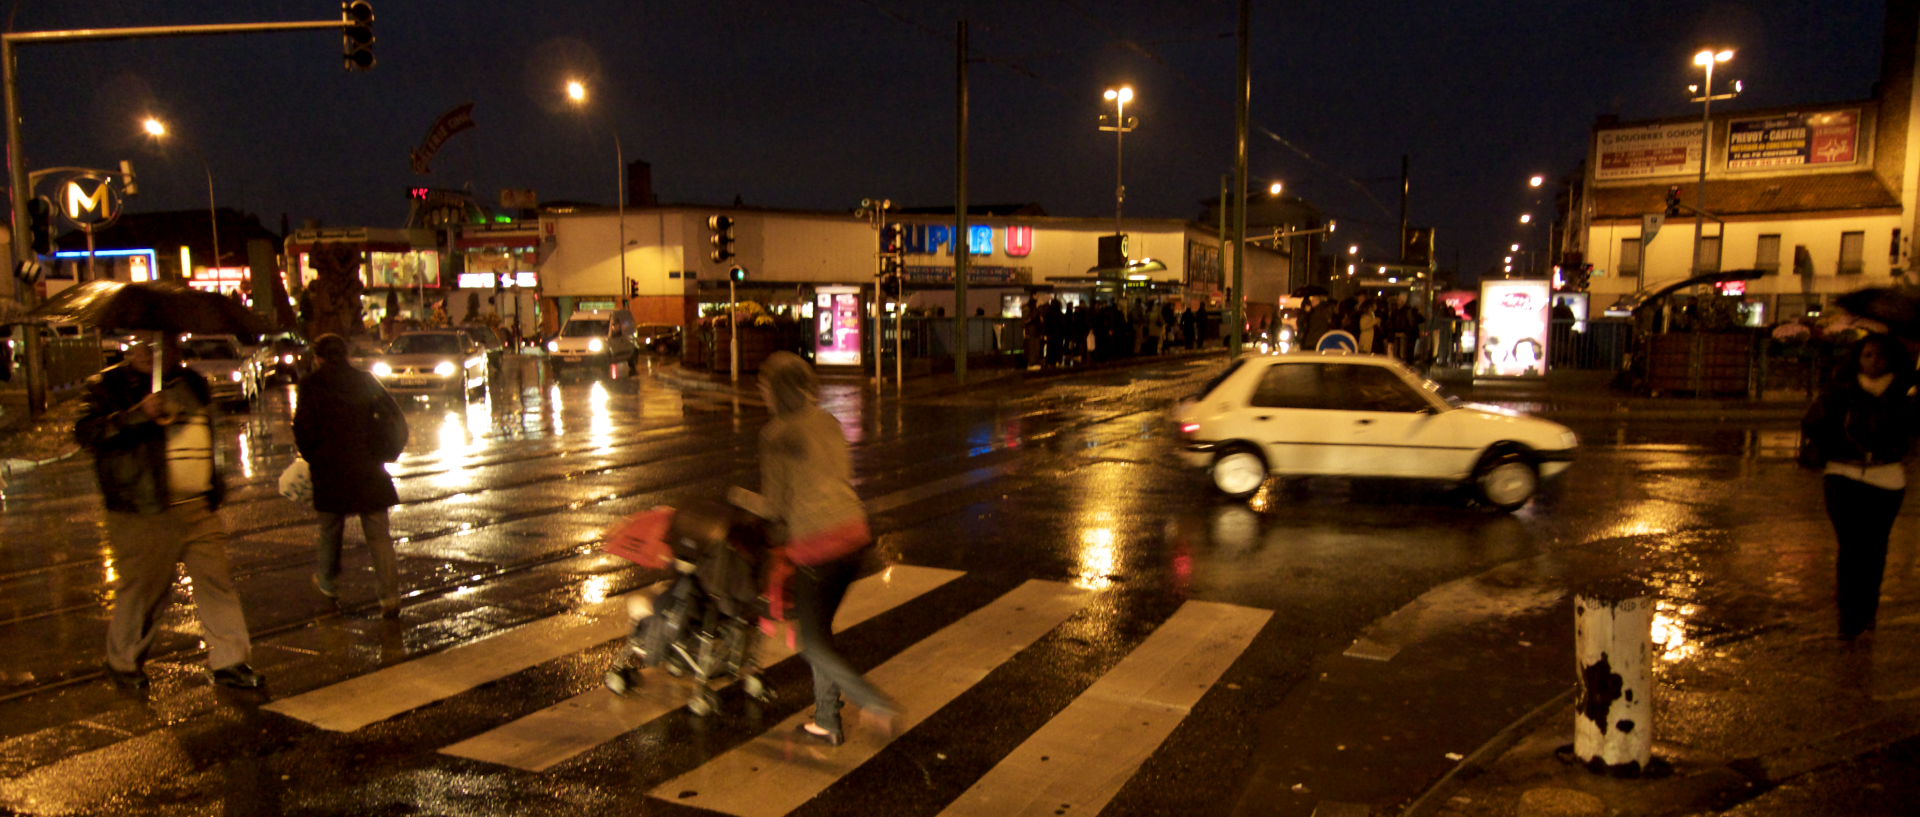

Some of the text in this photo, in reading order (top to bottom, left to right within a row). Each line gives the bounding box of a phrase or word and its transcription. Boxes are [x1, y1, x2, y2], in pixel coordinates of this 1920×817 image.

[1769, 127, 1806, 142] CARTIER
[68, 180, 110, 219] M
[1003, 225, 1032, 256] U
